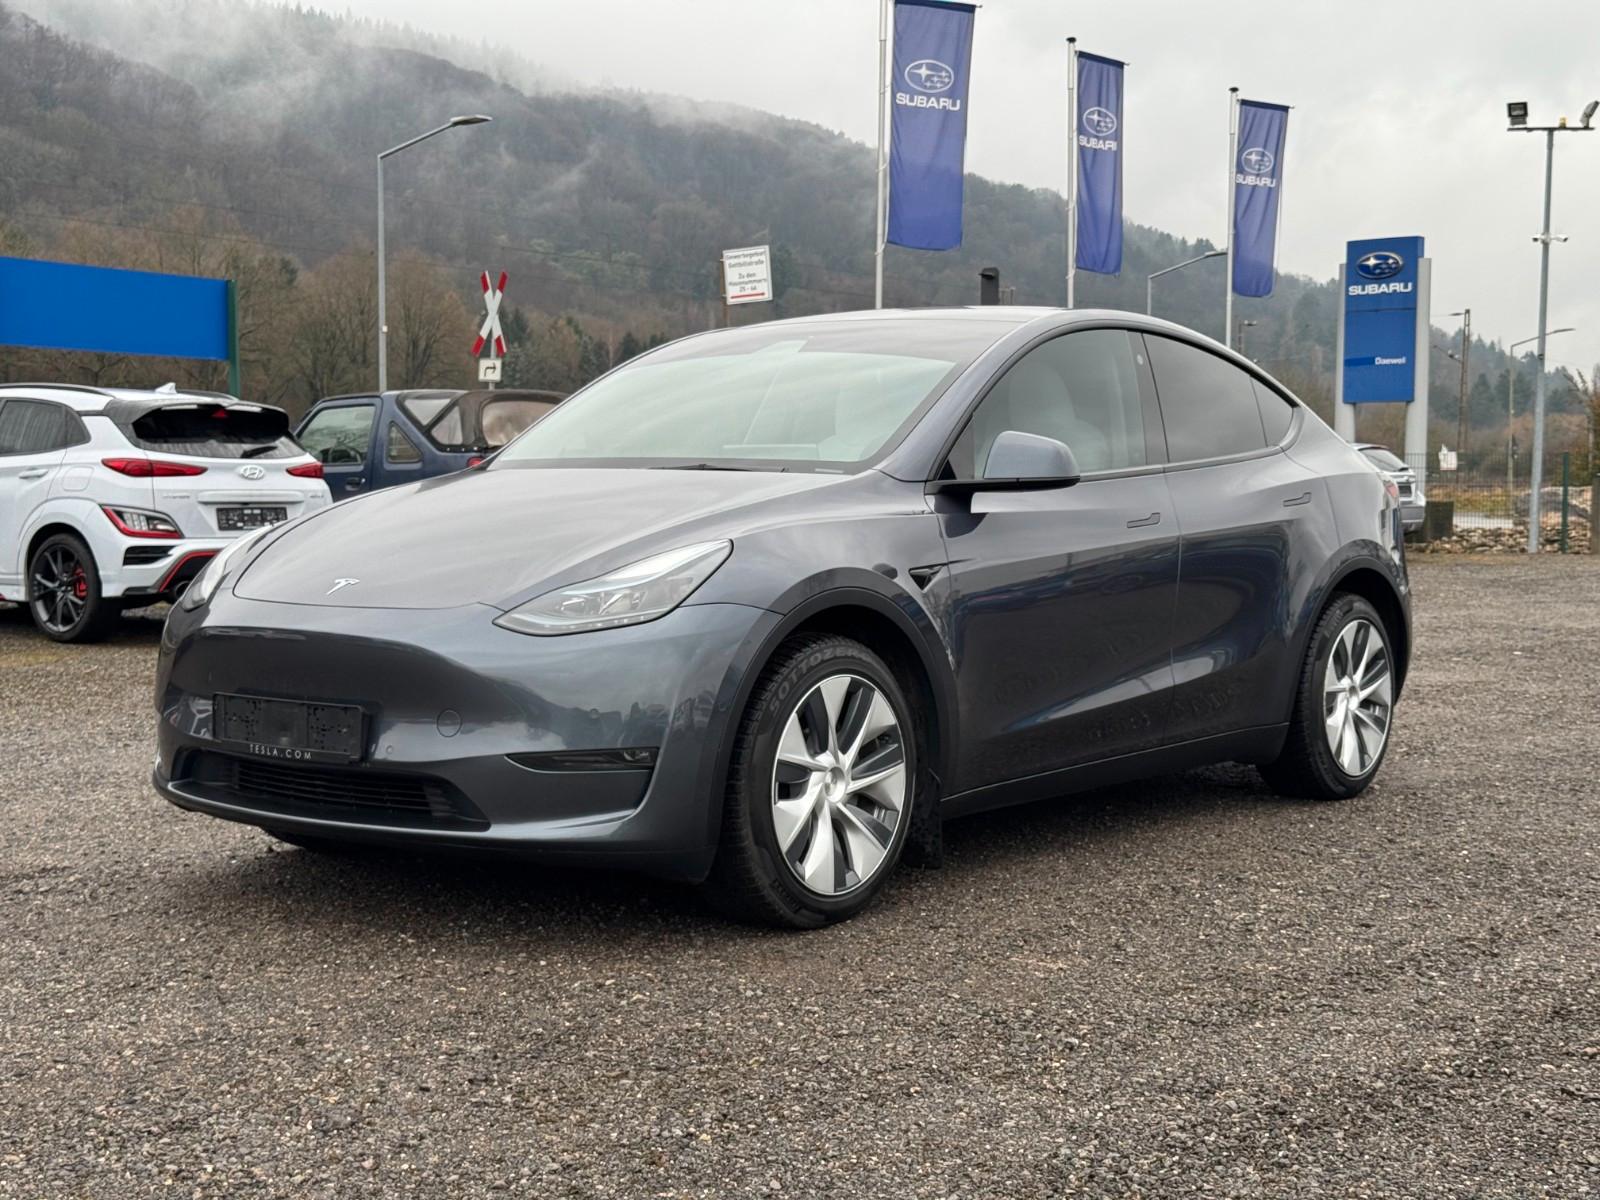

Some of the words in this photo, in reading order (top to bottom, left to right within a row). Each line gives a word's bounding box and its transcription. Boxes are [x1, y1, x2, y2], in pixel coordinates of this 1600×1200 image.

[895, 92, 961, 111] SUBARU
[1348, 281, 1413, 296] SUBARU
[250, 743, 312, 761] TESLA.COM
